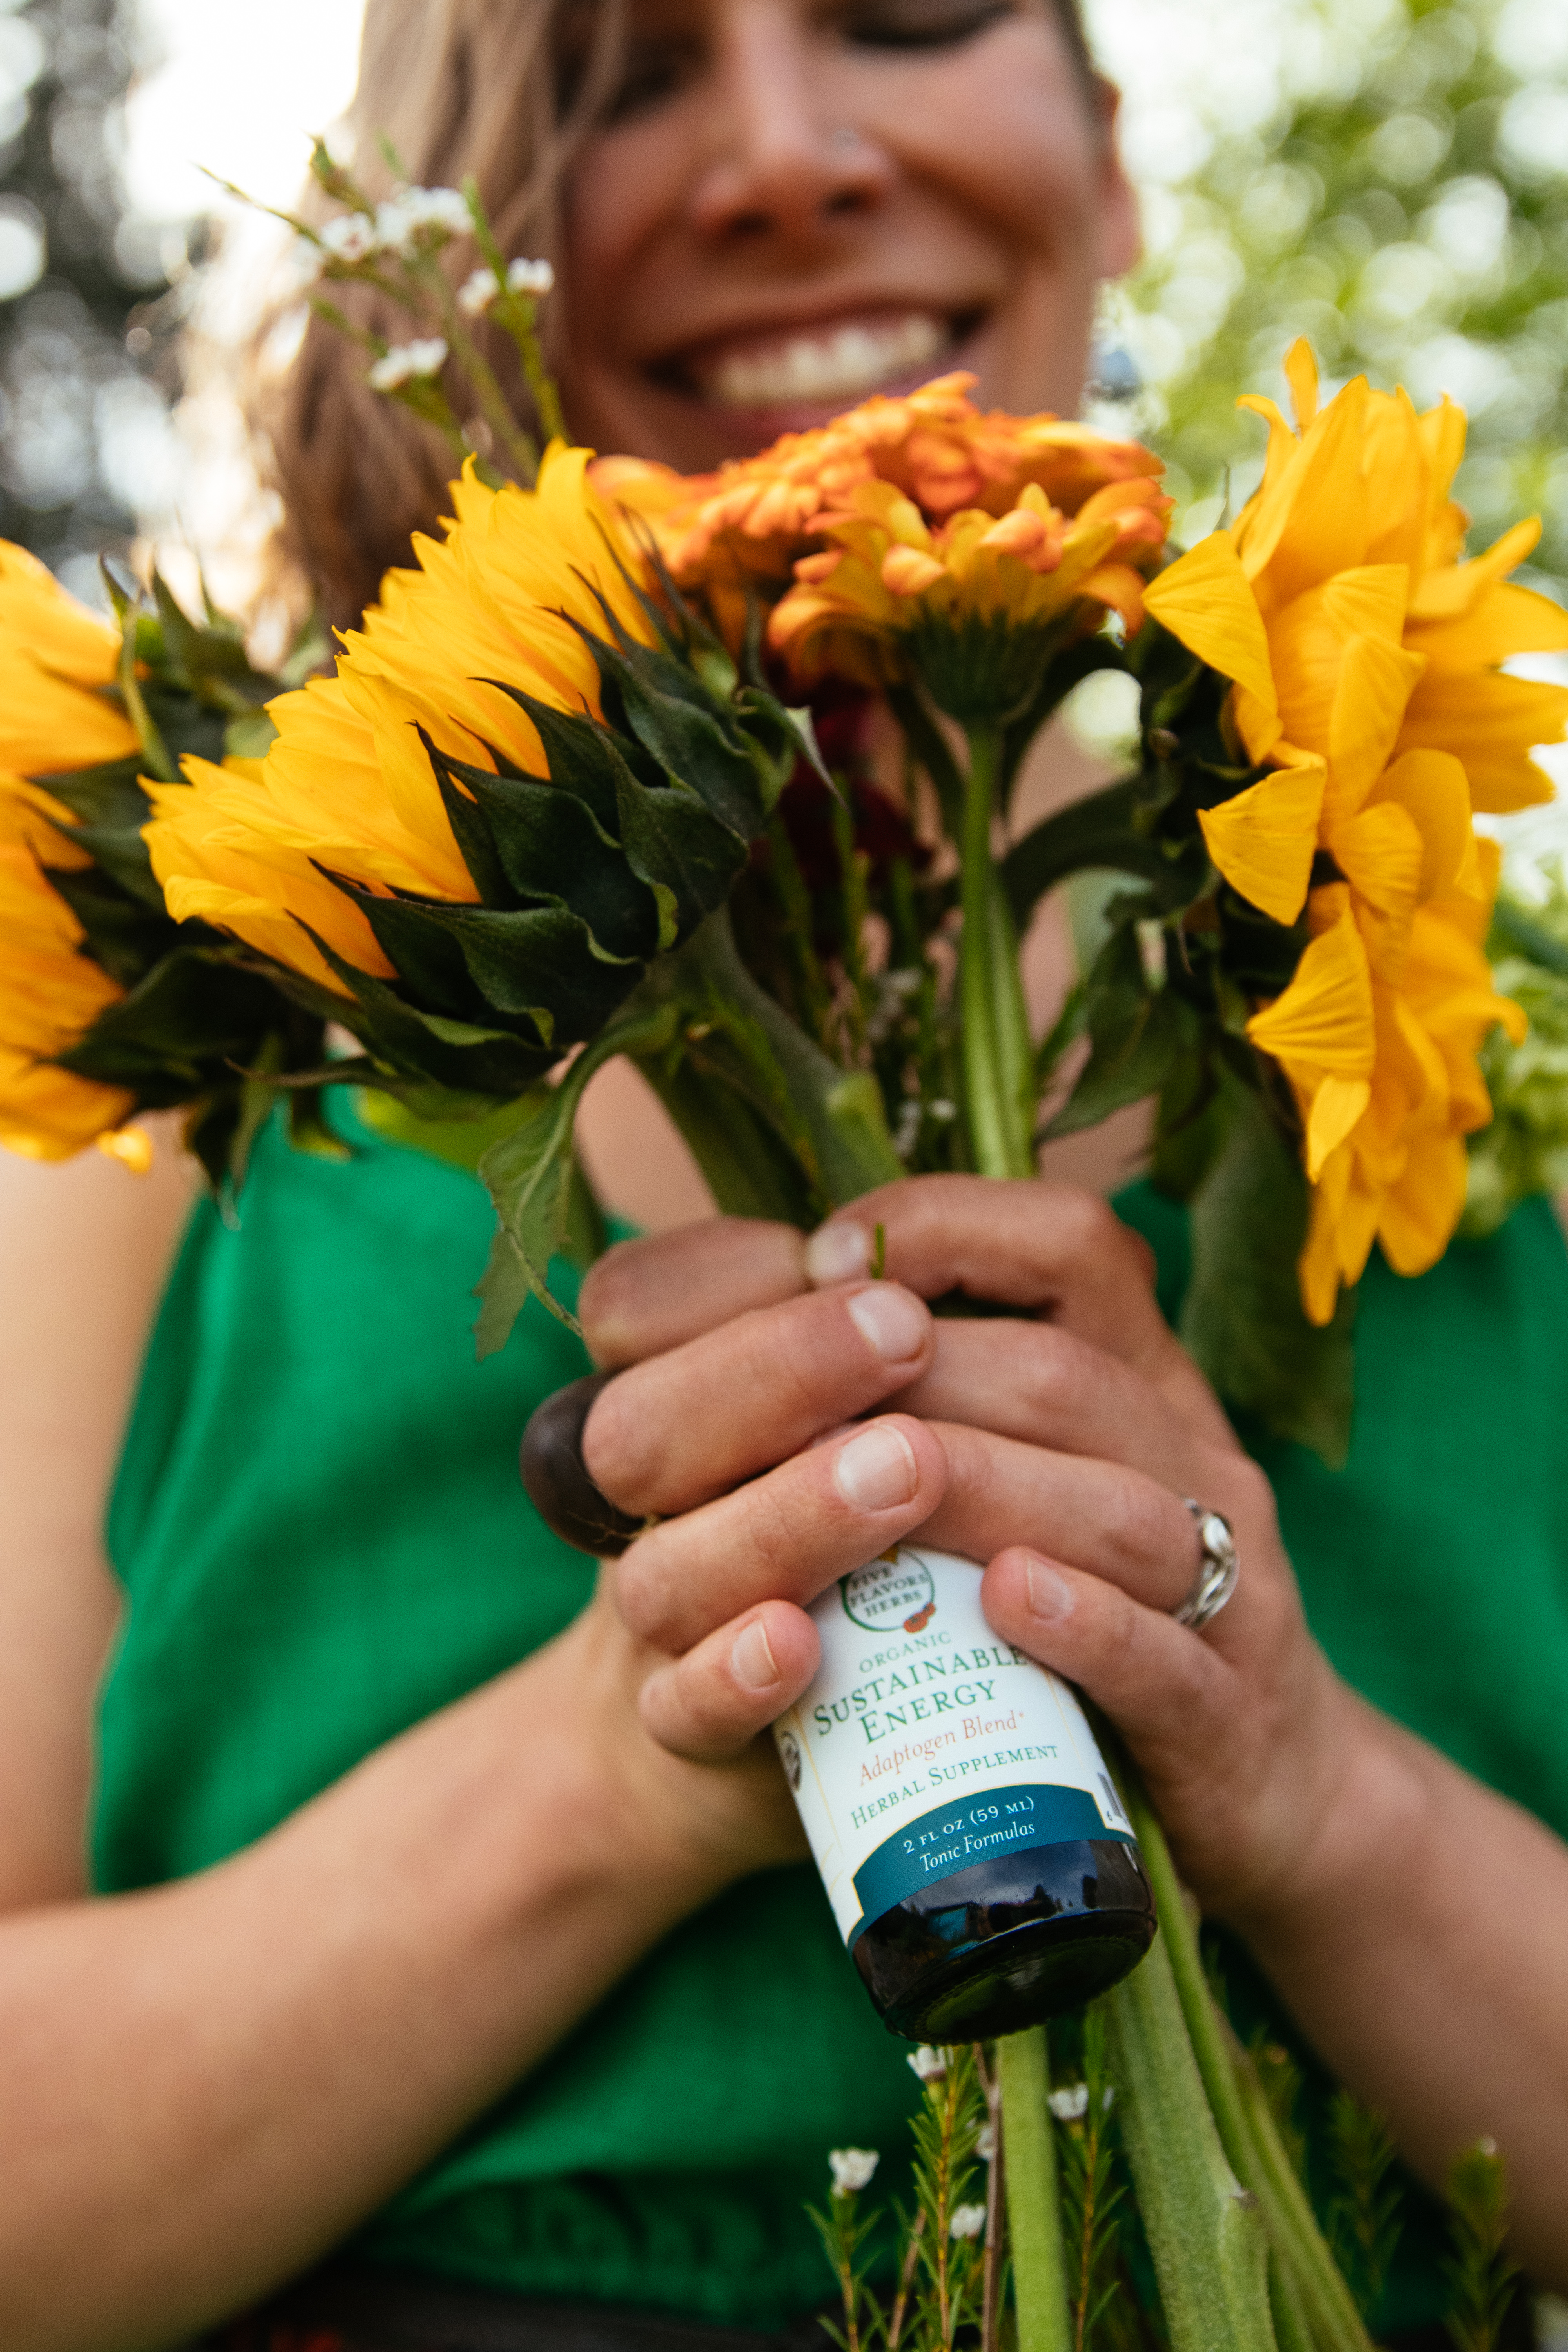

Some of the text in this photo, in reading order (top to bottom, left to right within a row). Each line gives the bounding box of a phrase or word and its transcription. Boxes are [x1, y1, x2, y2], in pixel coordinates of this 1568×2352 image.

[849, 1574, 930, 1607] FLAVORS
[851, 1567, 891, 1590] FIVE
[865, 1590, 921, 1617] HERBS
[860, 1631, 951, 1673] ORGANIC
[814, 1646, 1028, 1735] SUSTAINABLE
[858, 1679, 996, 1745] ENERGY
[860, 1731, 956, 1786] Adaptogen
[851, 1745, 1058, 1829] HERBAL SUPPLEMENT
[904, 1840, 915, 1854] 2
[919, 1831, 939, 1847] FL
[943, 1819, 965, 1835] OZ
[970, 1806, 998, 1826] (59
[920, 1821, 1035, 1872] Tonic Formulas
